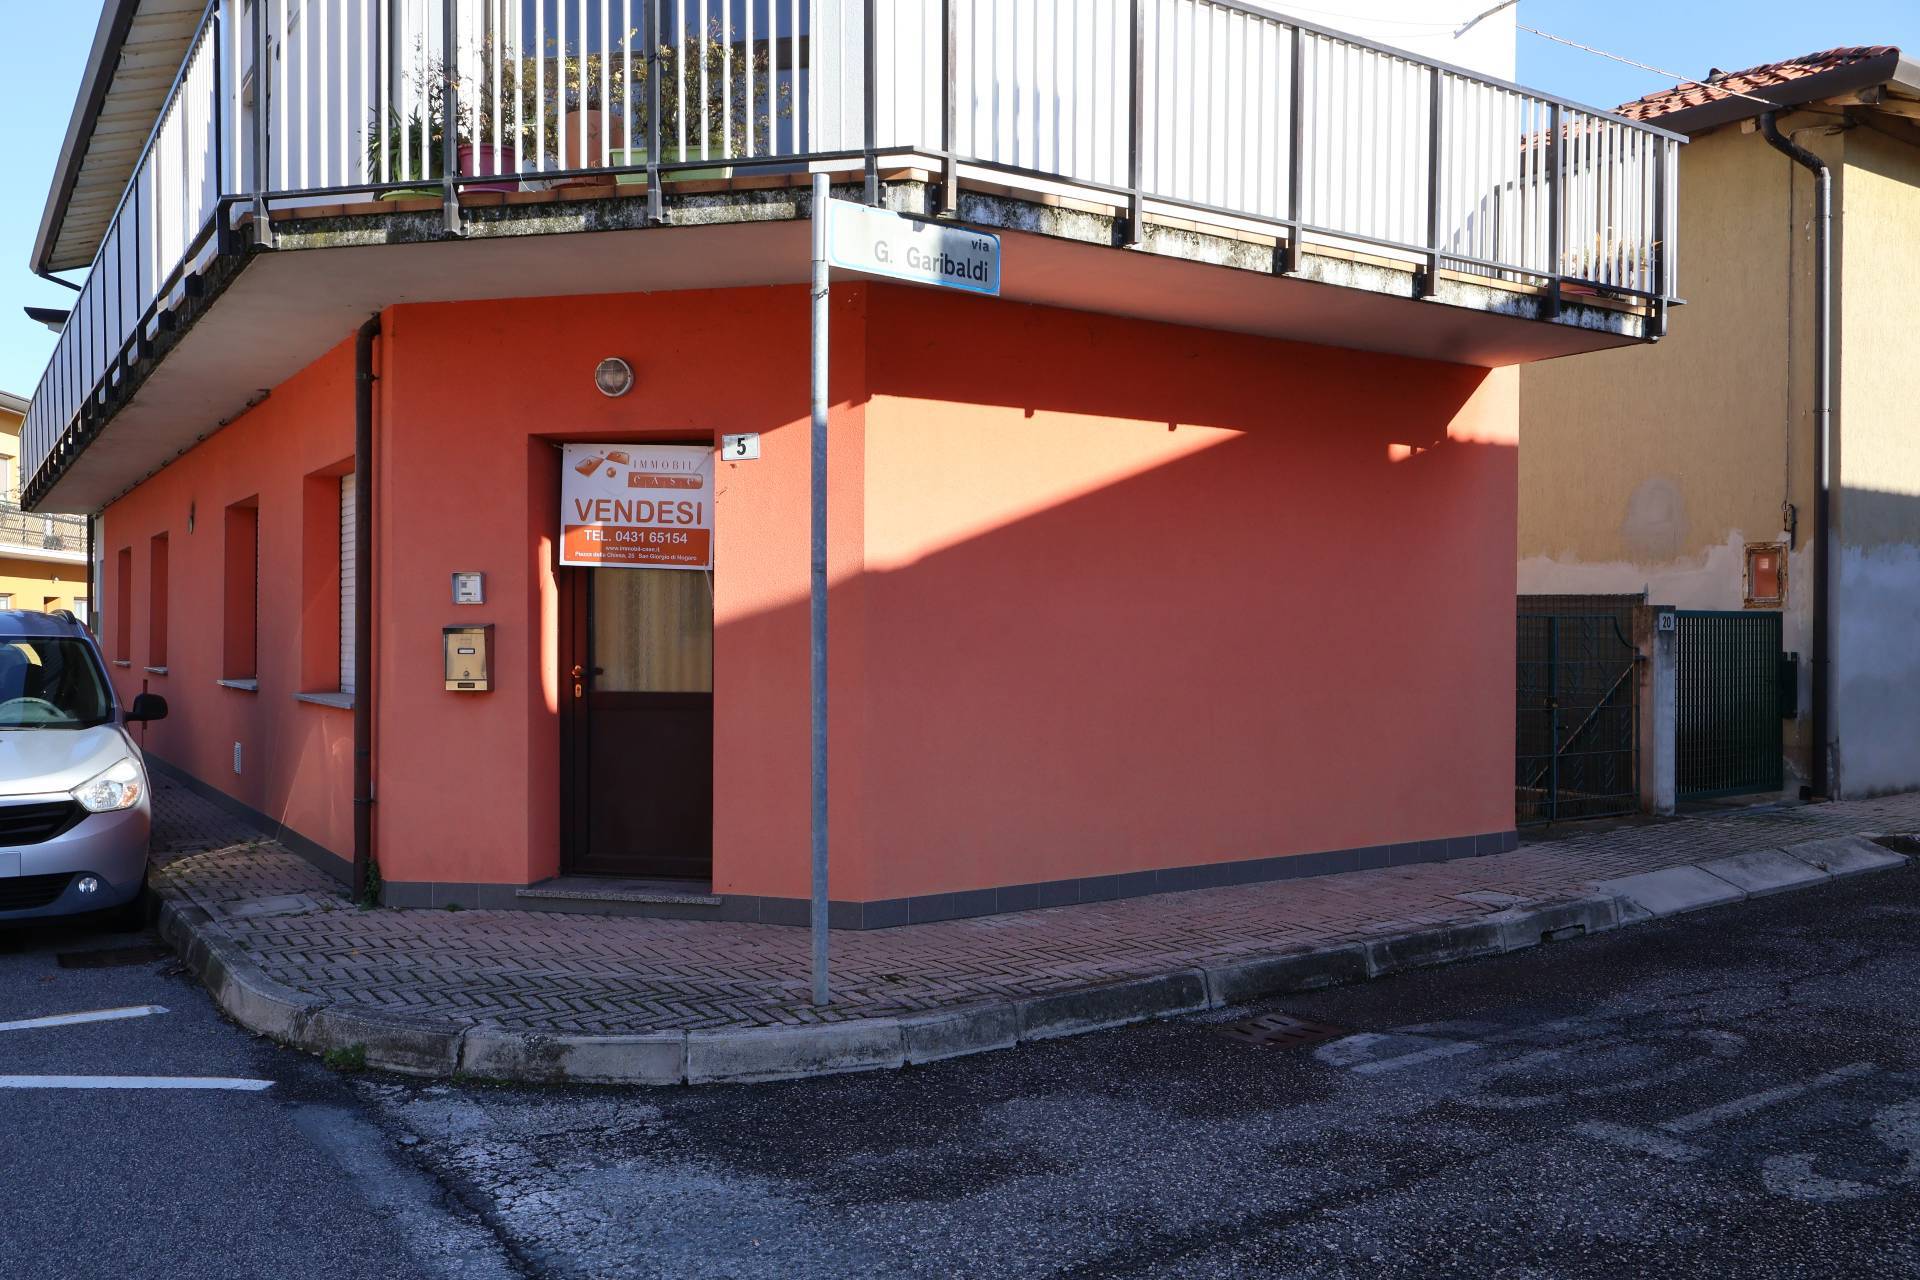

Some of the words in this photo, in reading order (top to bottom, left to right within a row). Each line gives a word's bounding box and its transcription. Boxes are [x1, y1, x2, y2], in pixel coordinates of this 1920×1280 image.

[971, 239, 990, 252] via
[874, 240, 894, 264] G.
[906, 246, 988, 282] Garibaldi
[736, 437, 747, 456] 5
[633, 459, 693, 471] IMMOBIL
[575, 498, 702, 526] VENDESI
[584, 530, 612, 542] TEL.
[615, 531, 644, 543] 0431
[649, 532, 688, 544] 65154
[1662, 615, 1672, 628] 20
